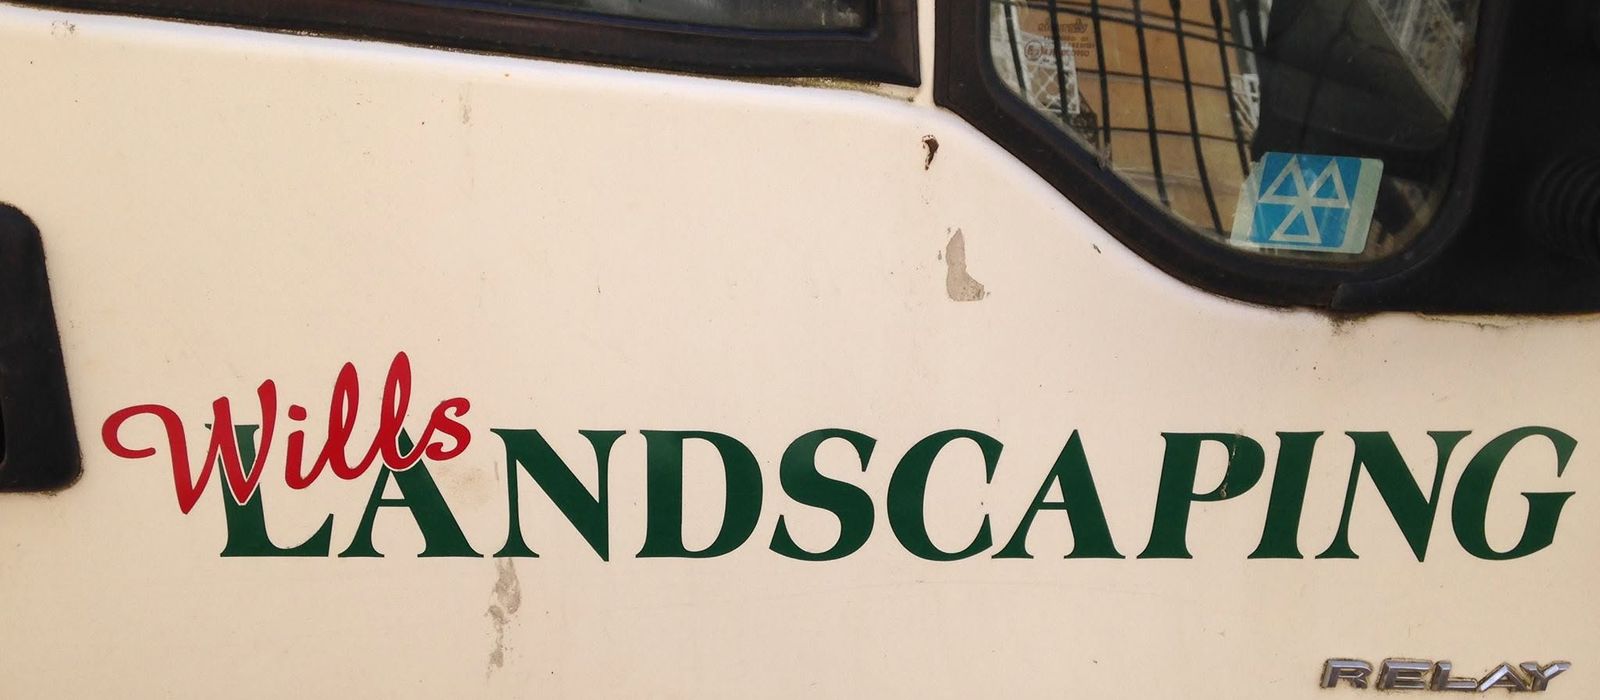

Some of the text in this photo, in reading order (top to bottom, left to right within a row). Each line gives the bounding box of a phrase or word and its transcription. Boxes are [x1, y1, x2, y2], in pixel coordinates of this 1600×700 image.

[102, 351, 471, 514] Wills
[204, 424, 1577, 562] LANDSCAPING
[1320, 658, 1571, 692] RELAY
